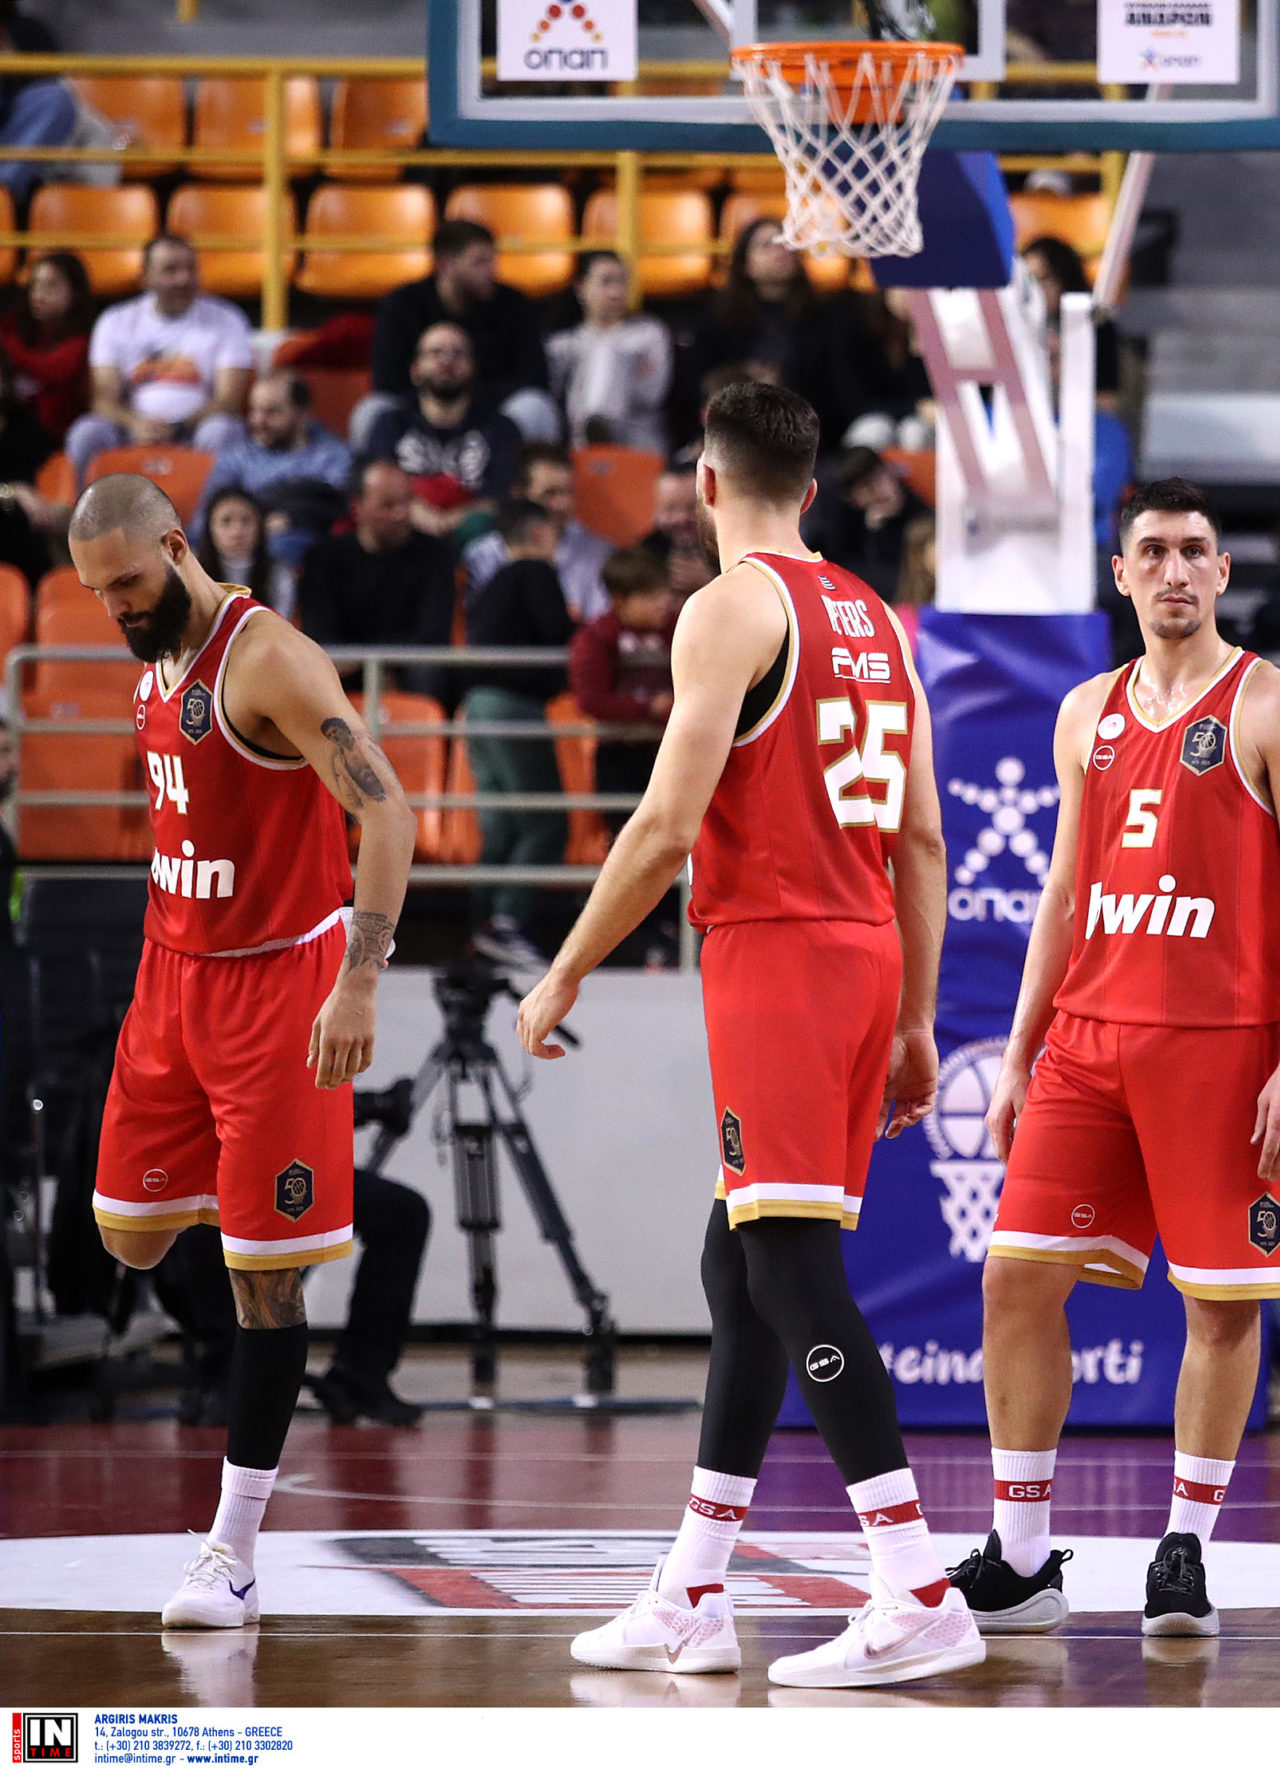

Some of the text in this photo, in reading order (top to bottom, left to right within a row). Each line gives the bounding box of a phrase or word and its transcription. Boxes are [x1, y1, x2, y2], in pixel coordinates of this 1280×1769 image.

[831, 647, 891, 681] PMS
[147, 751, 190, 815] 94
[816, 697, 908, 833] 25
[1121, 788, 1163, 848] 5
